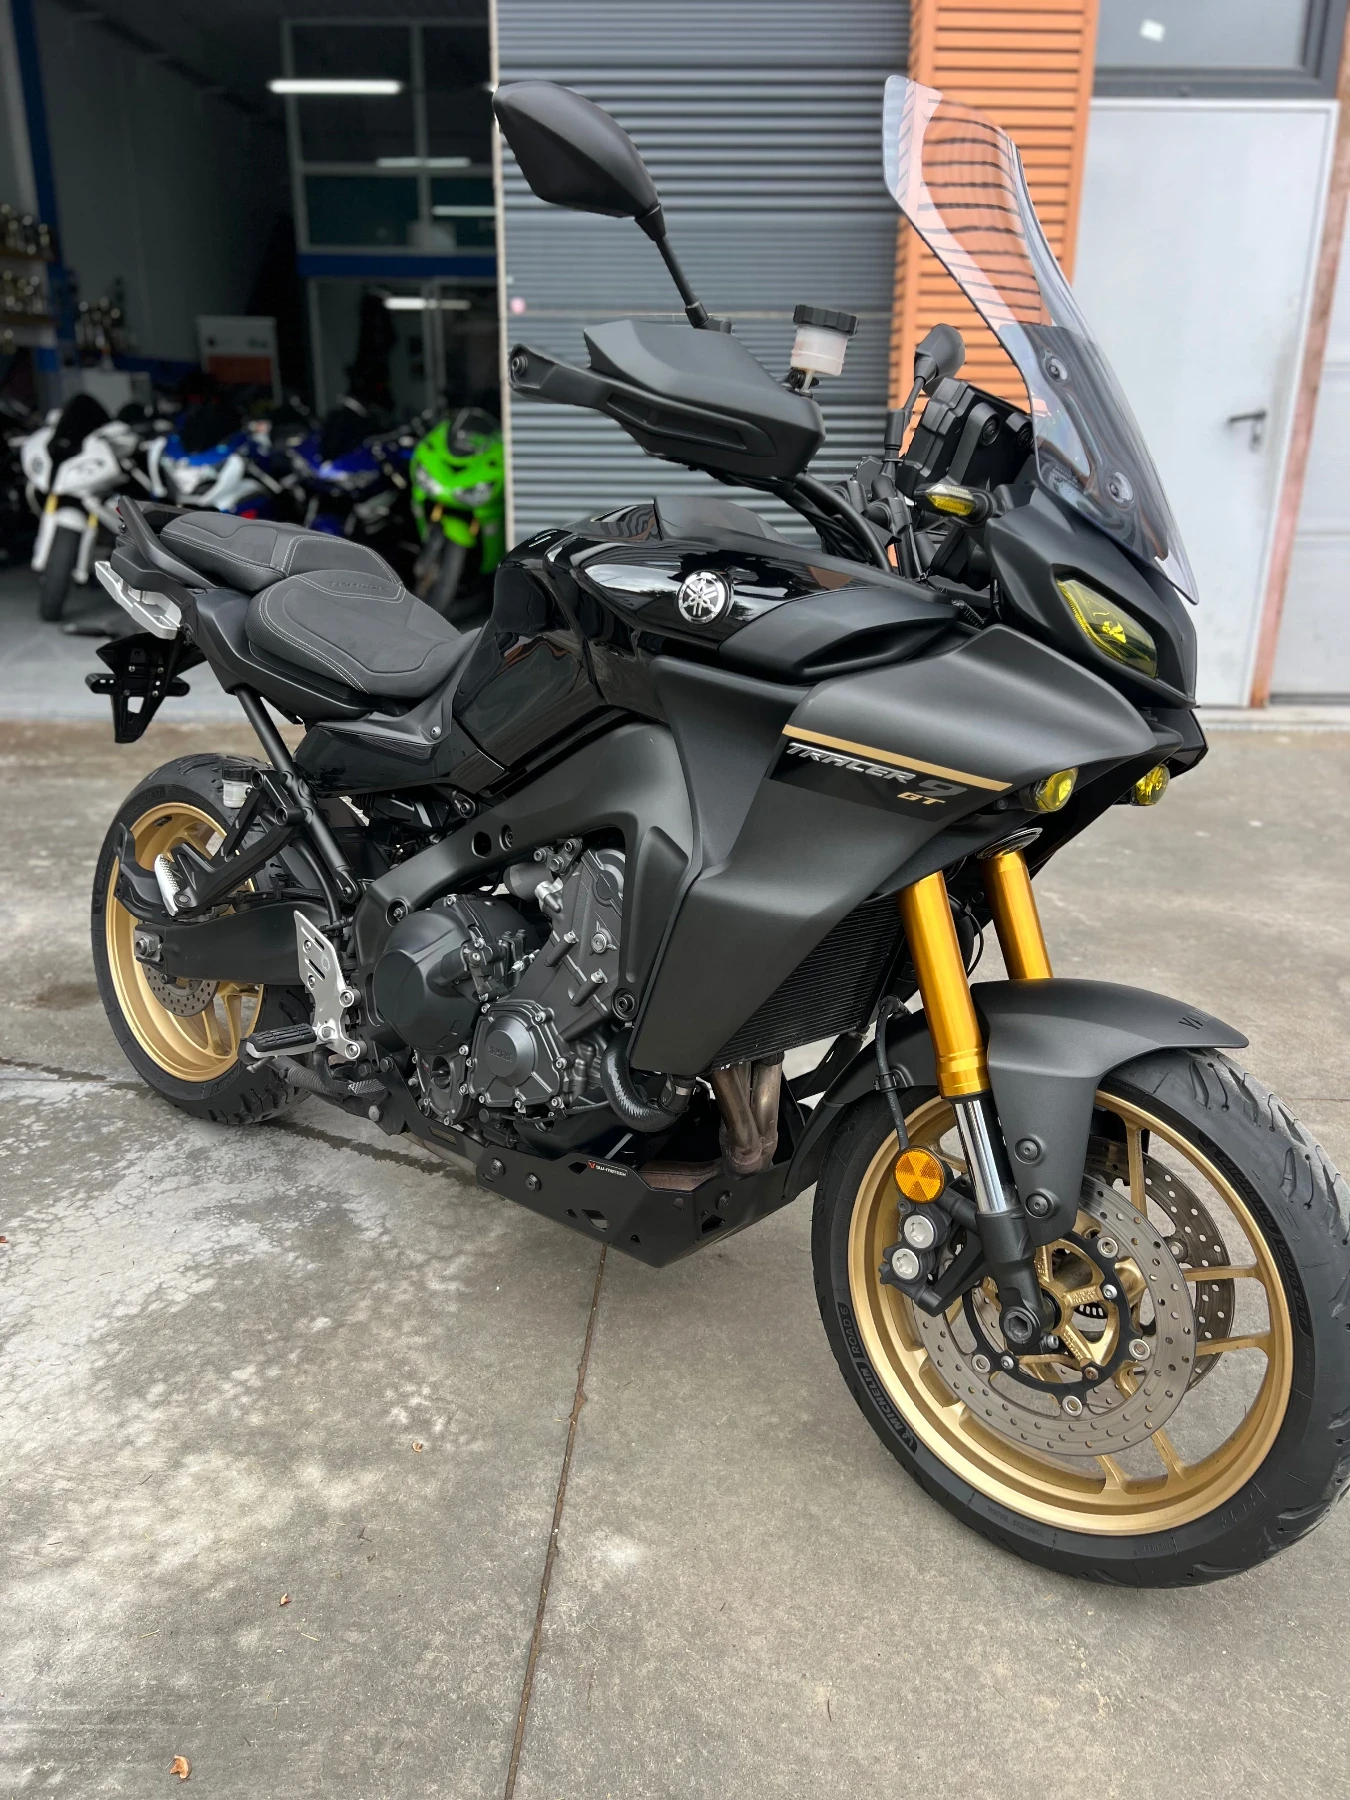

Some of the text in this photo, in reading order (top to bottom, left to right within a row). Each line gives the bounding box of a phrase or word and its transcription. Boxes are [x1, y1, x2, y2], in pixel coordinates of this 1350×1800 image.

[786, 742, 968, 797] TRACER 9
[897, 791, 946, 805] GT
[1218, 1156, 1275, 1229] MICHELIN
[843, 1318, 861, 1355] ROAD
[860, 1366, 904, 1431] MICHELIN
